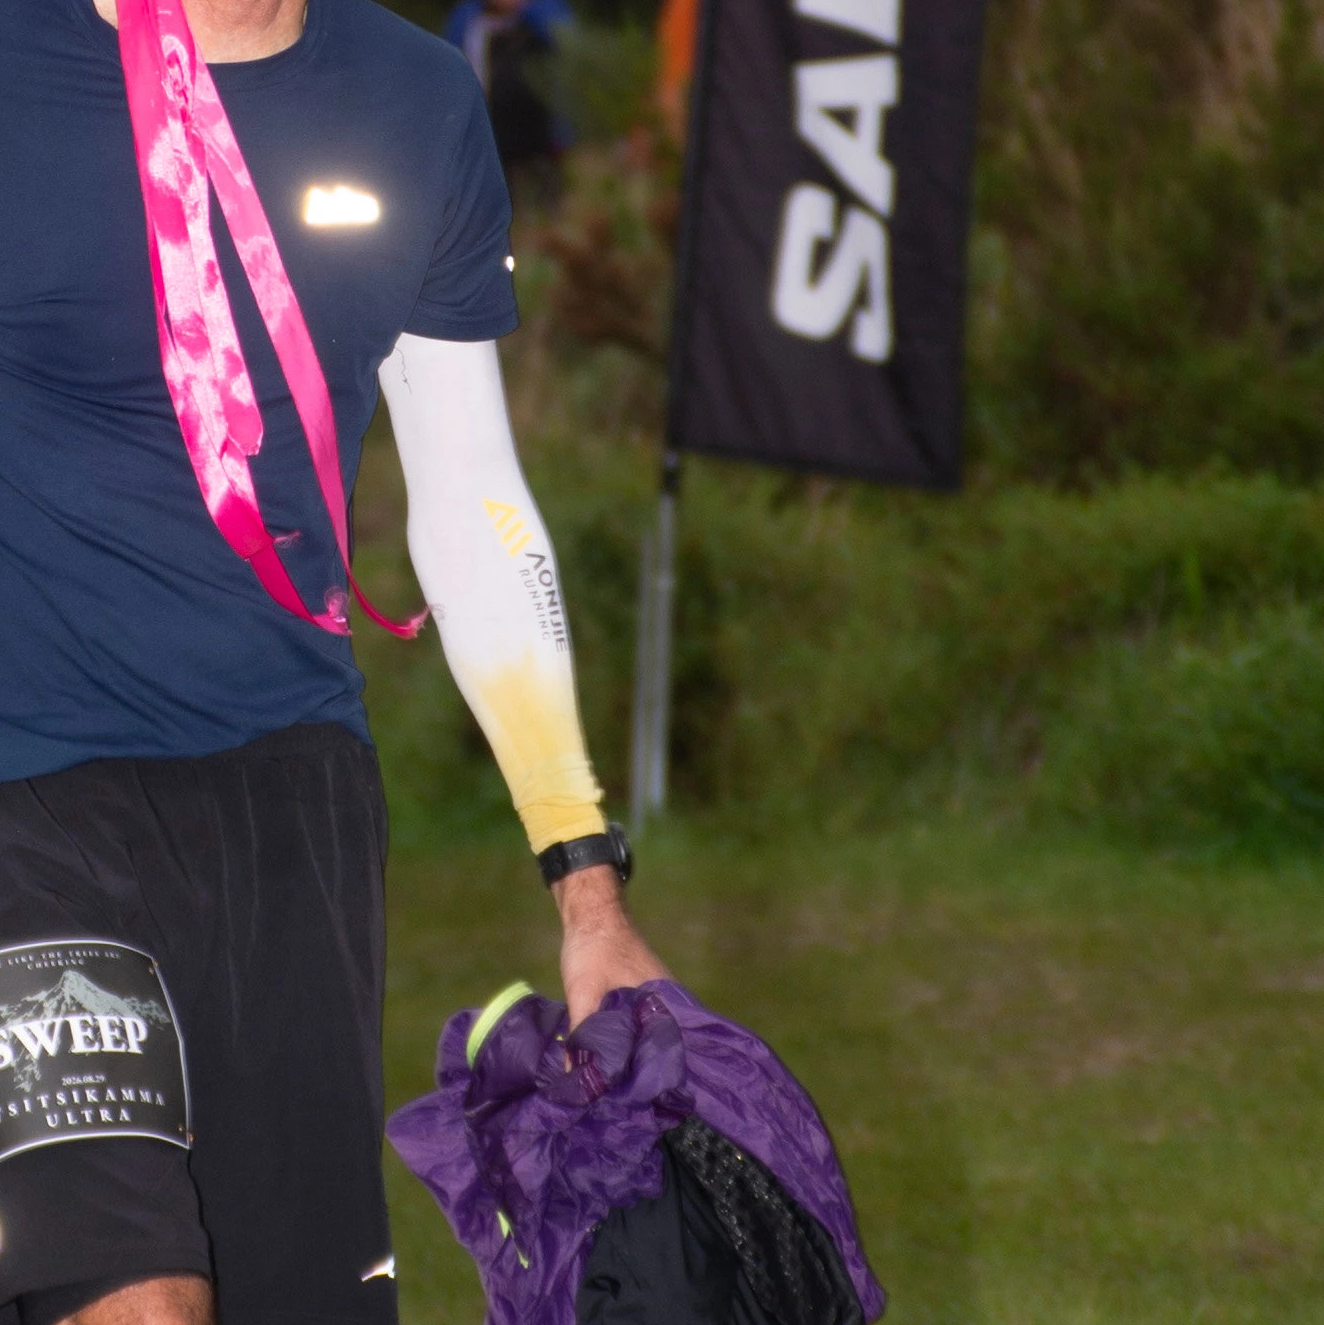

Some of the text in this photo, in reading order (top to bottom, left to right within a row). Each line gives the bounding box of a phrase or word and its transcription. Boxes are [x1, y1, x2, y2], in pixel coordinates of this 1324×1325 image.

[519, 569, 551, 641] RUNNING
[7, 954, 34, 966] LIKE
[41, 950, 62, 960] THE
[45, 1106, 132, 1129] ULTRA
